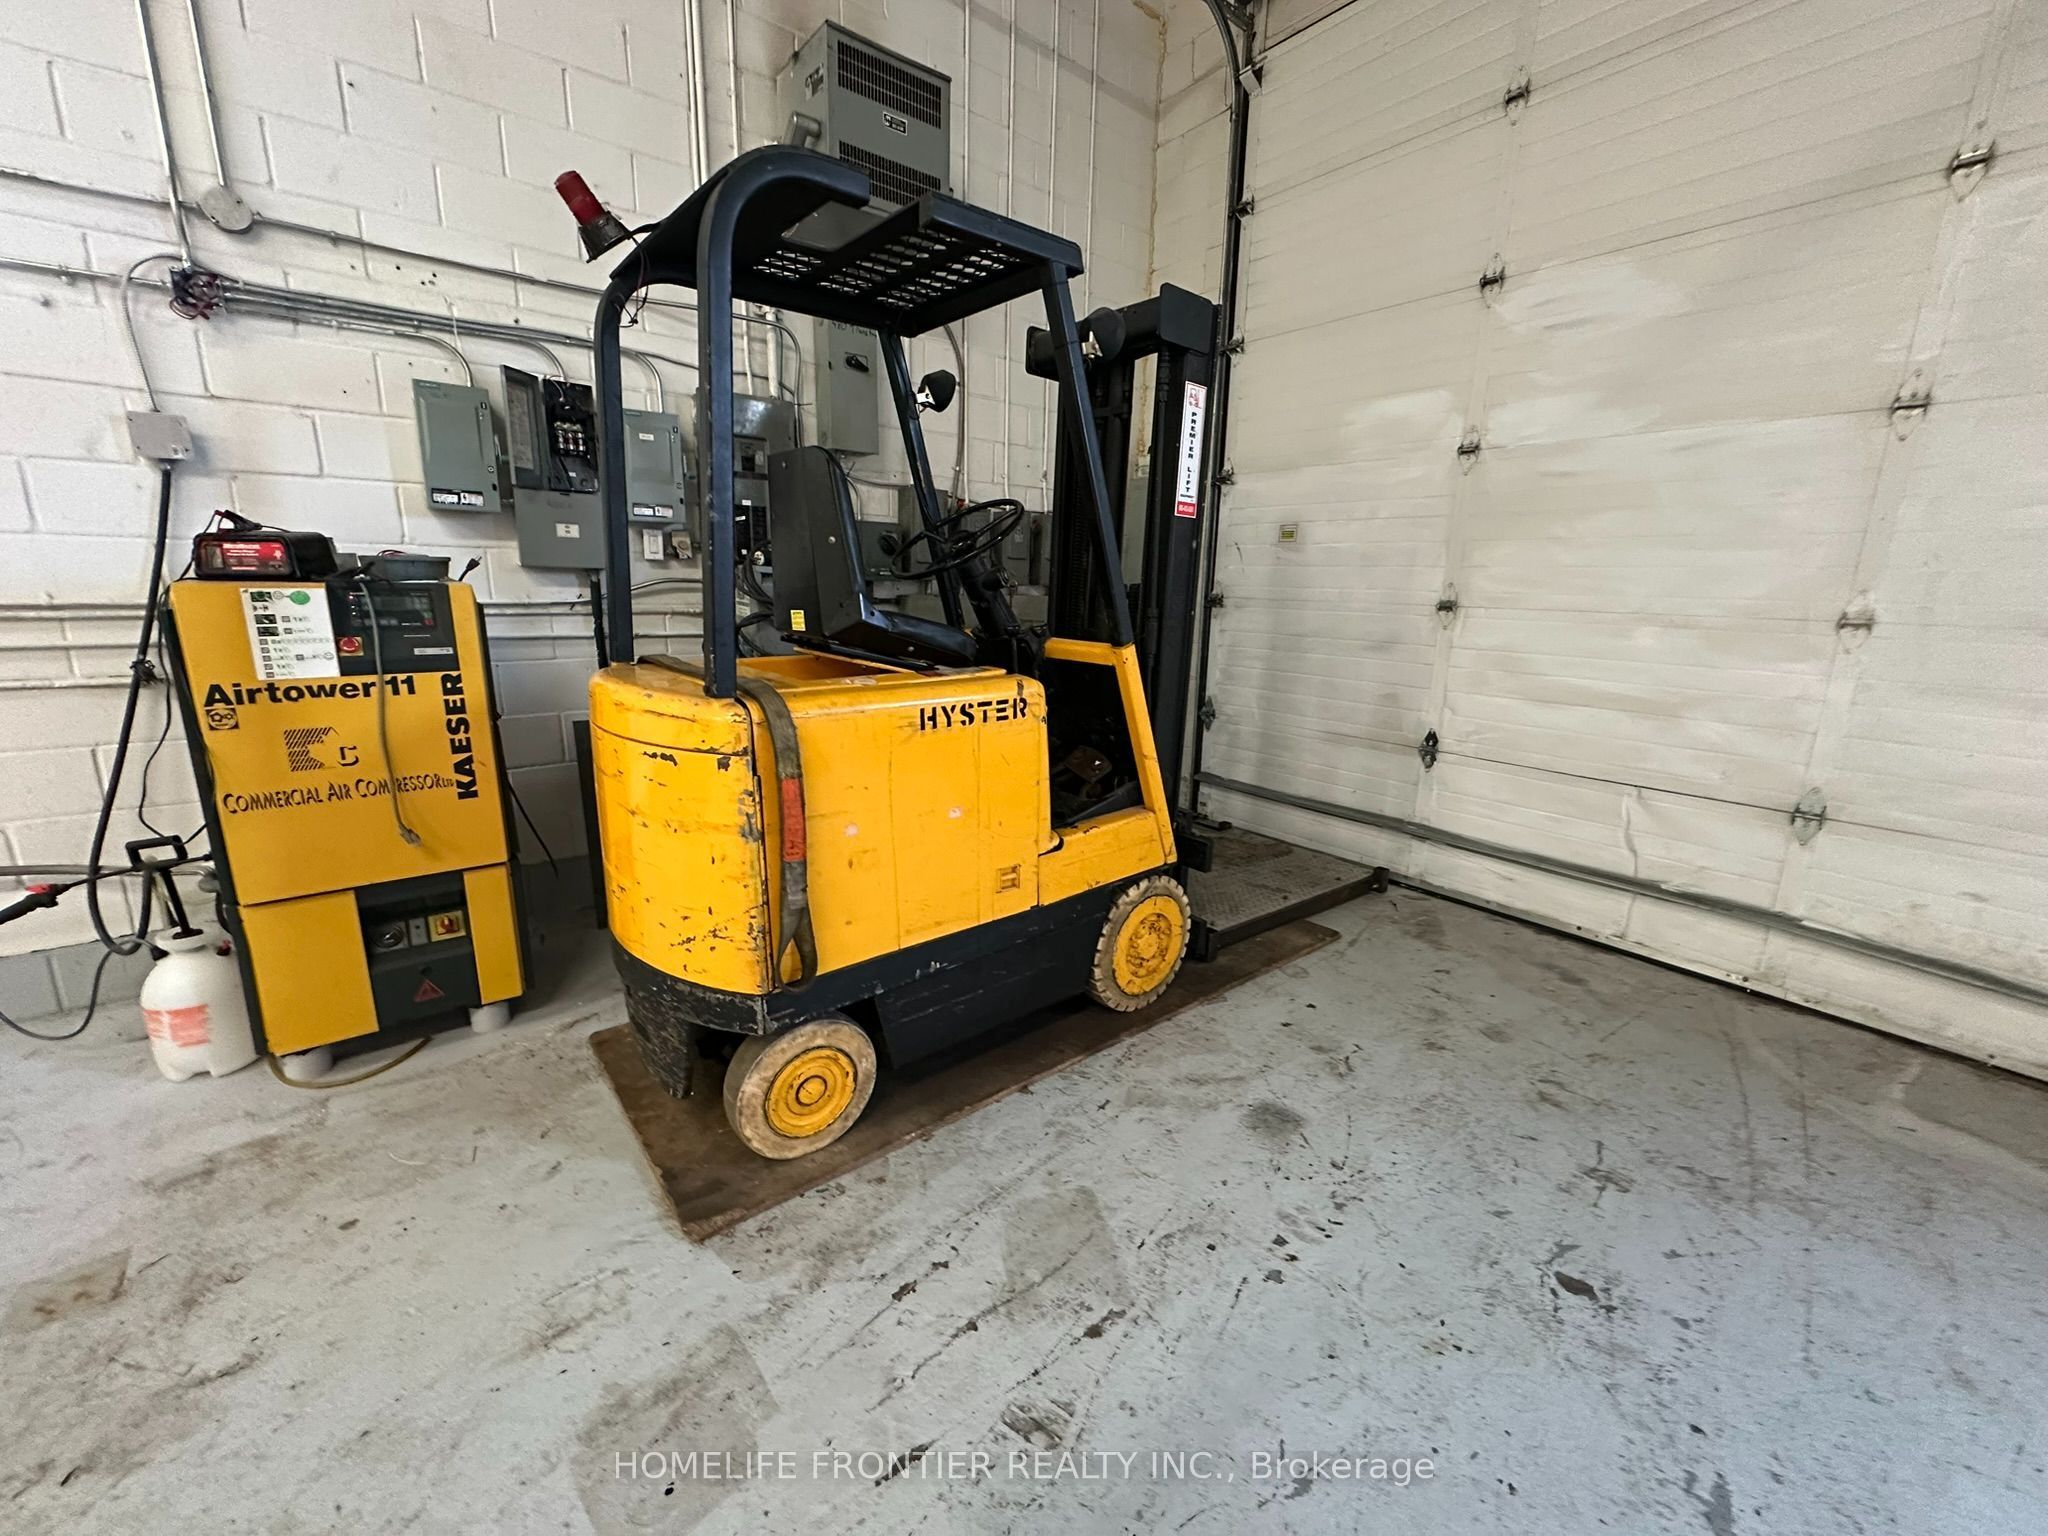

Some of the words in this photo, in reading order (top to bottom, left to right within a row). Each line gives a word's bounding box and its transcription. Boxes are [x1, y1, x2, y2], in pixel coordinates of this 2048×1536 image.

[1188, 411, 1198, 459] PREMIER
[204, 680, 376, 707] Airtower
[385, 675, 416, 696] 11
[920, 697, 1028, 731] HYSTER
[440, 672, 479, 800] KAESER
[223, 788, 324, 814] COMMERCIAL
[328, 780, 353, 802] AIR
[355, 773, 444, 798] COMRESSOR
